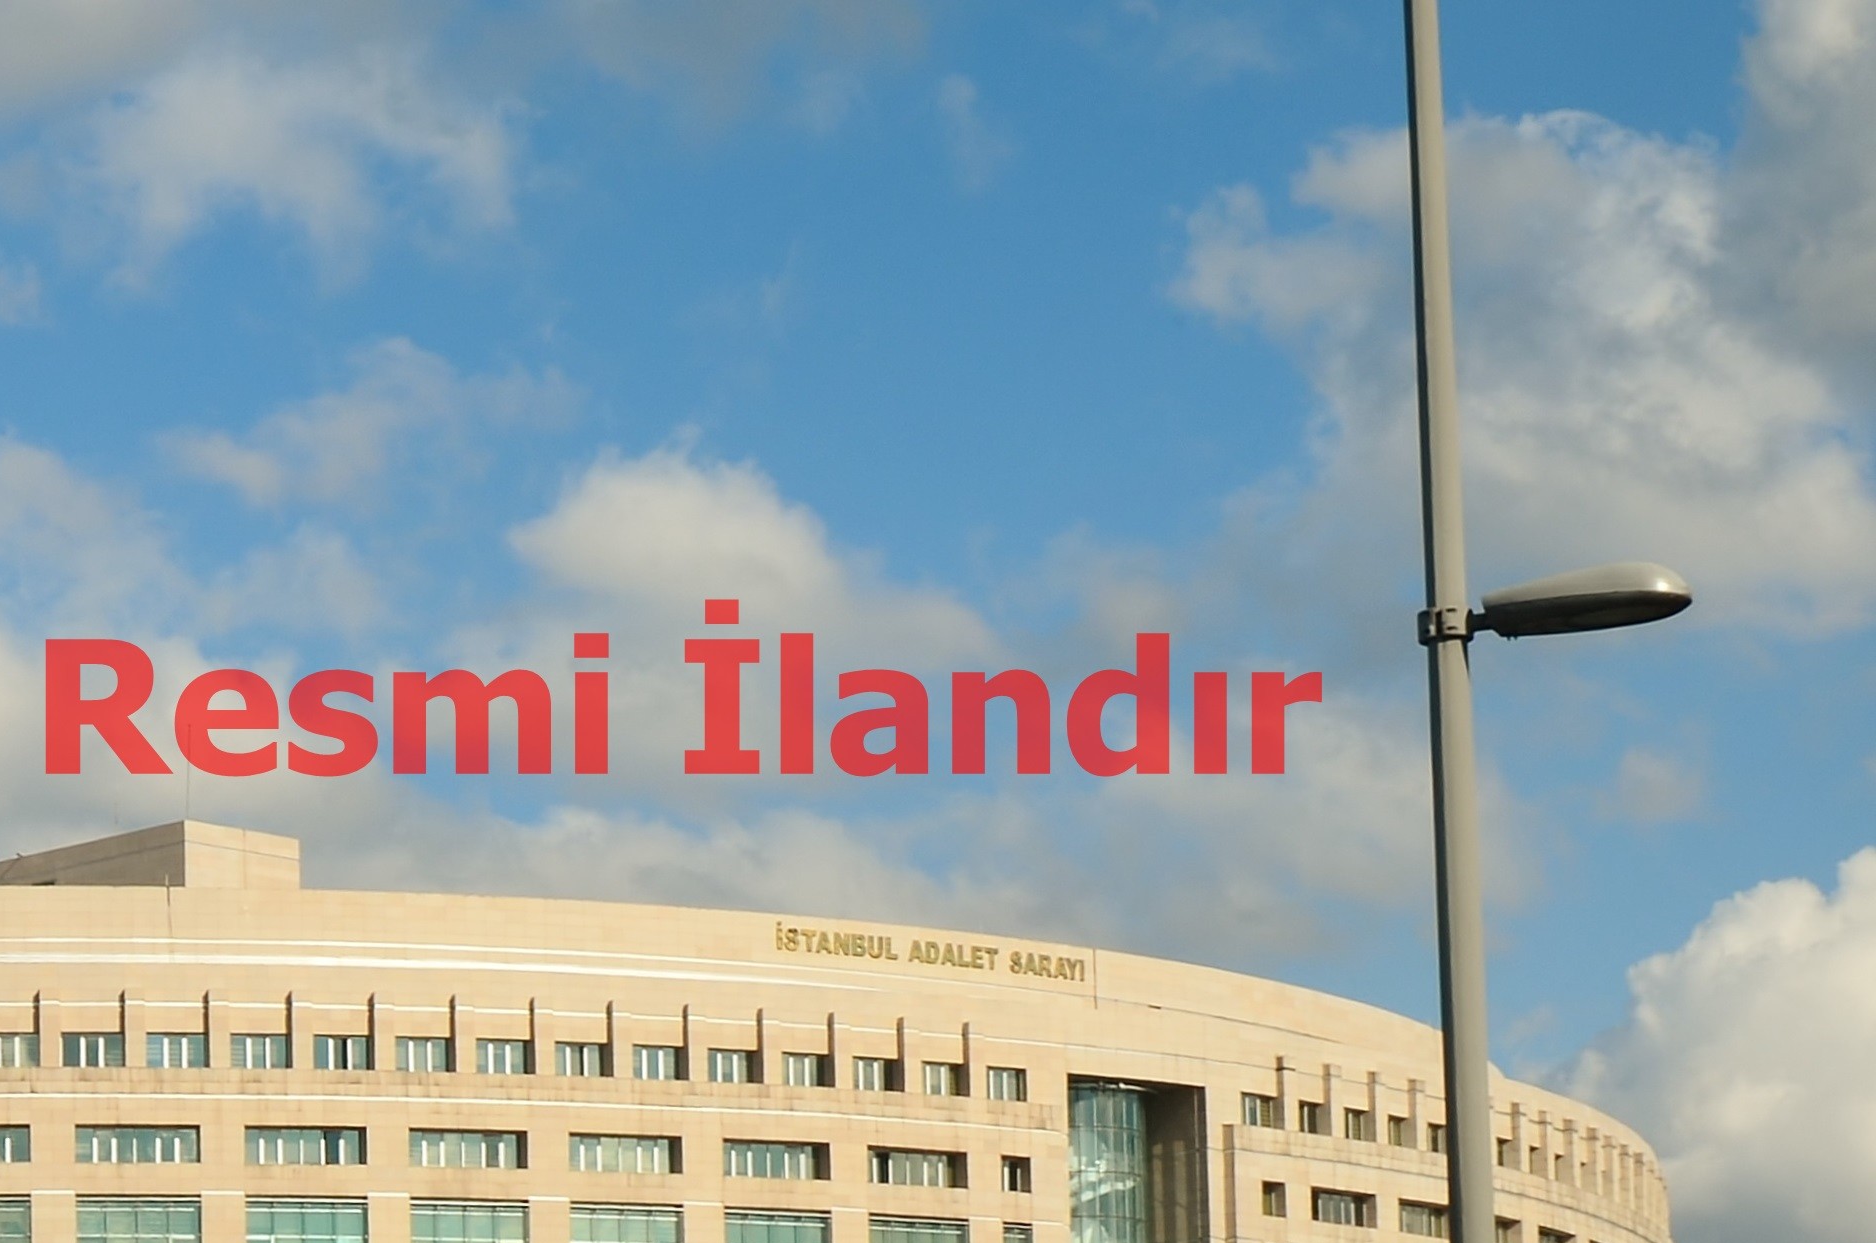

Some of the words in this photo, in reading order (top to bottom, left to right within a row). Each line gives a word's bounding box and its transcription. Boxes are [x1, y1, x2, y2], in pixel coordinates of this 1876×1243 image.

[775, 921, 899, 961] İSTANBUL
[908, 939, 999, 971] ADALET
[1009, 951, 1085, 982] SARAYI
